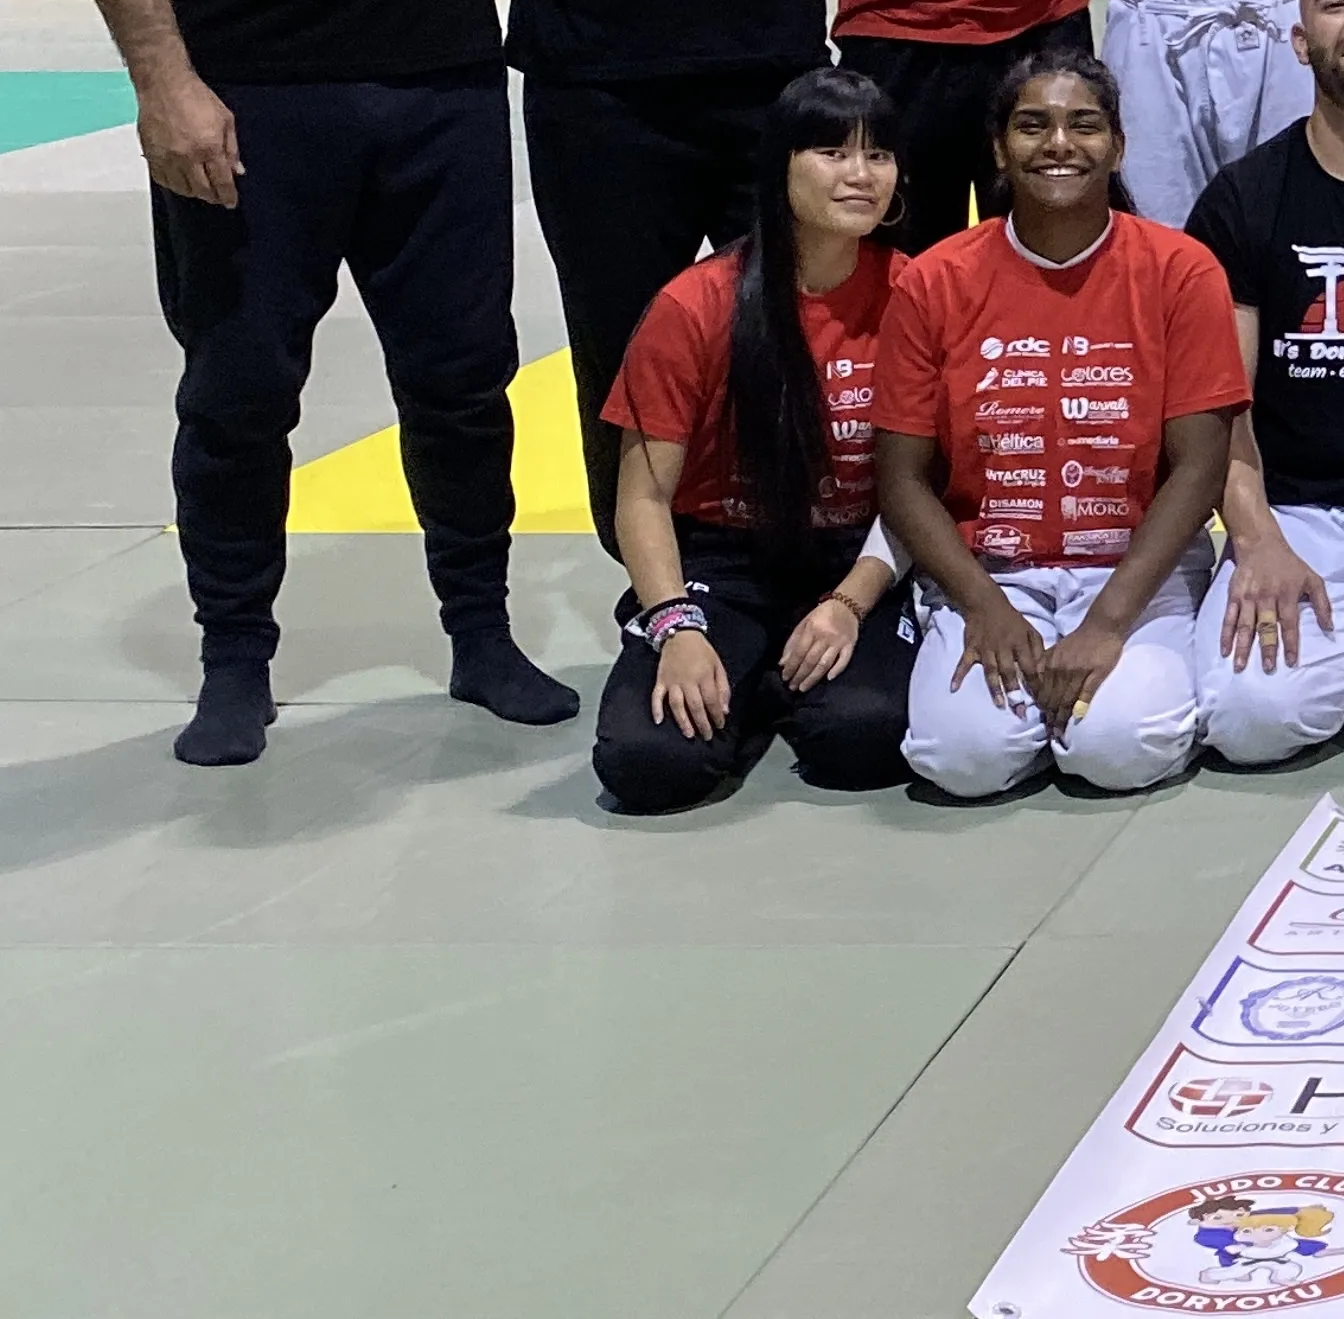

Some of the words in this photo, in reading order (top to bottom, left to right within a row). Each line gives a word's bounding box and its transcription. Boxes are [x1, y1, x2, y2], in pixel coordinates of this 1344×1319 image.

[1007, 337, 1050, 352] rdc
[1273, 339, 1300, 360] It's
[1288, 363, 1327, 378] team
[1157, 1116, 1311, 1135] Soluciones
[1320, 1121, 1337, 1135] y
[1189, 1175, 1284, 1205] JUDO
[1129, 1284, 1324, 1313] DORYOKU
